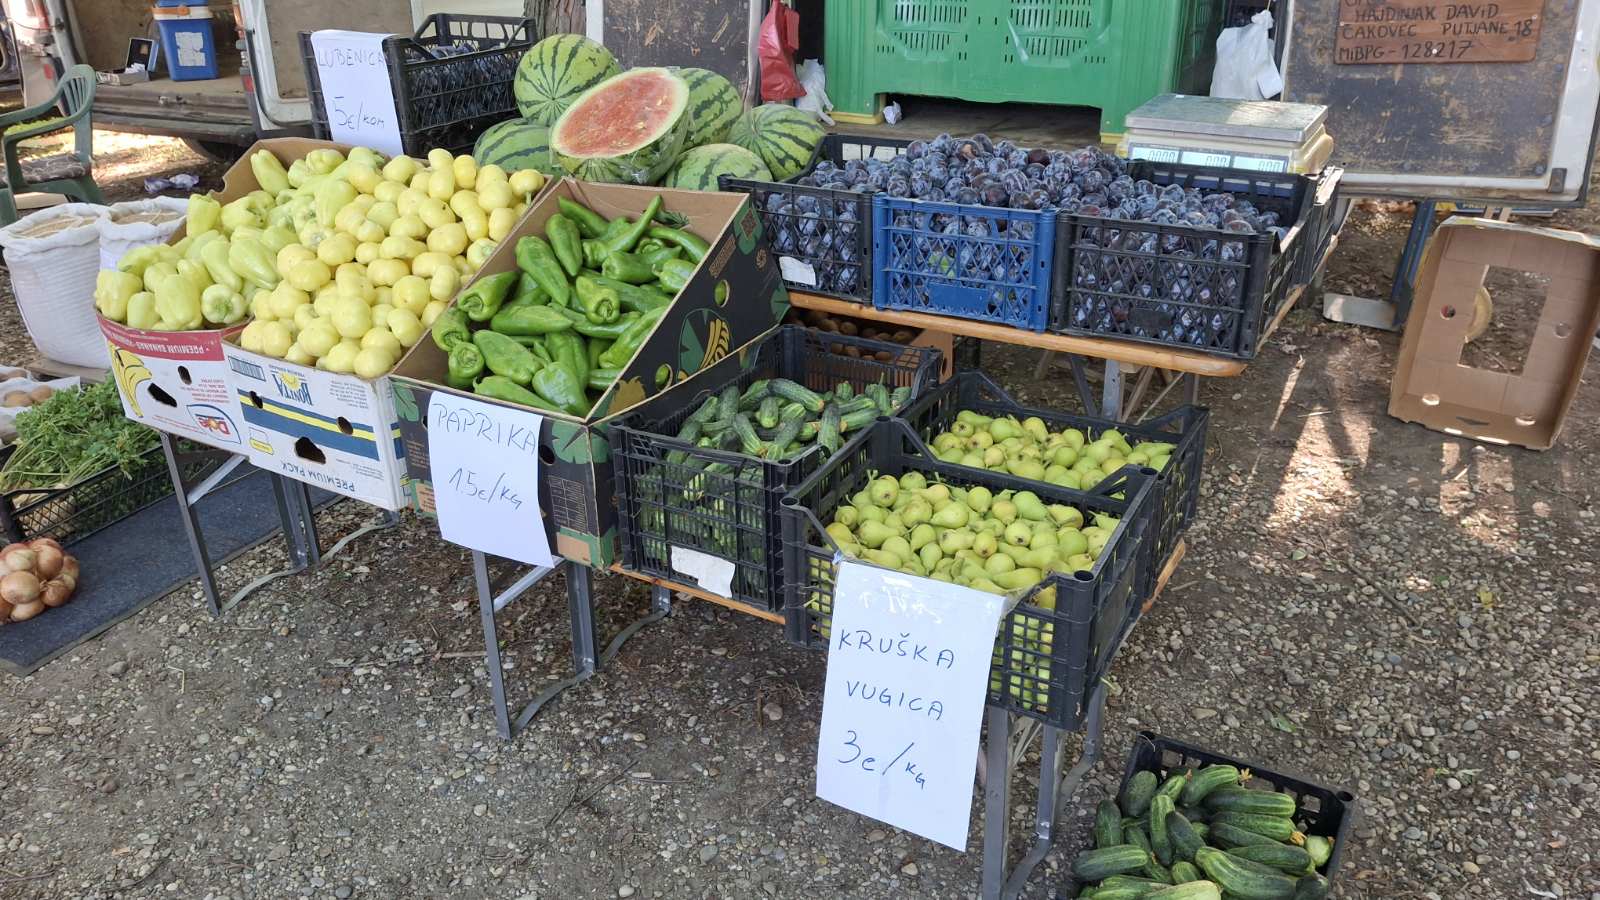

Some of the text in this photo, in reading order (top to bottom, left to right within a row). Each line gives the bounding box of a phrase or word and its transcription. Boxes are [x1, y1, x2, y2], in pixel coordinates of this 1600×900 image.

[1514, 19, 1533, 37] 18
[272, 373, 314, 407] BONITA
[432, 403, 537, 455] PAPRIKA
[280, 460, 356, 493] PREMIUM PACK
[838, 629, 955, 669] KRUŠKA
[846, 681, 944, 721] VUGICA
